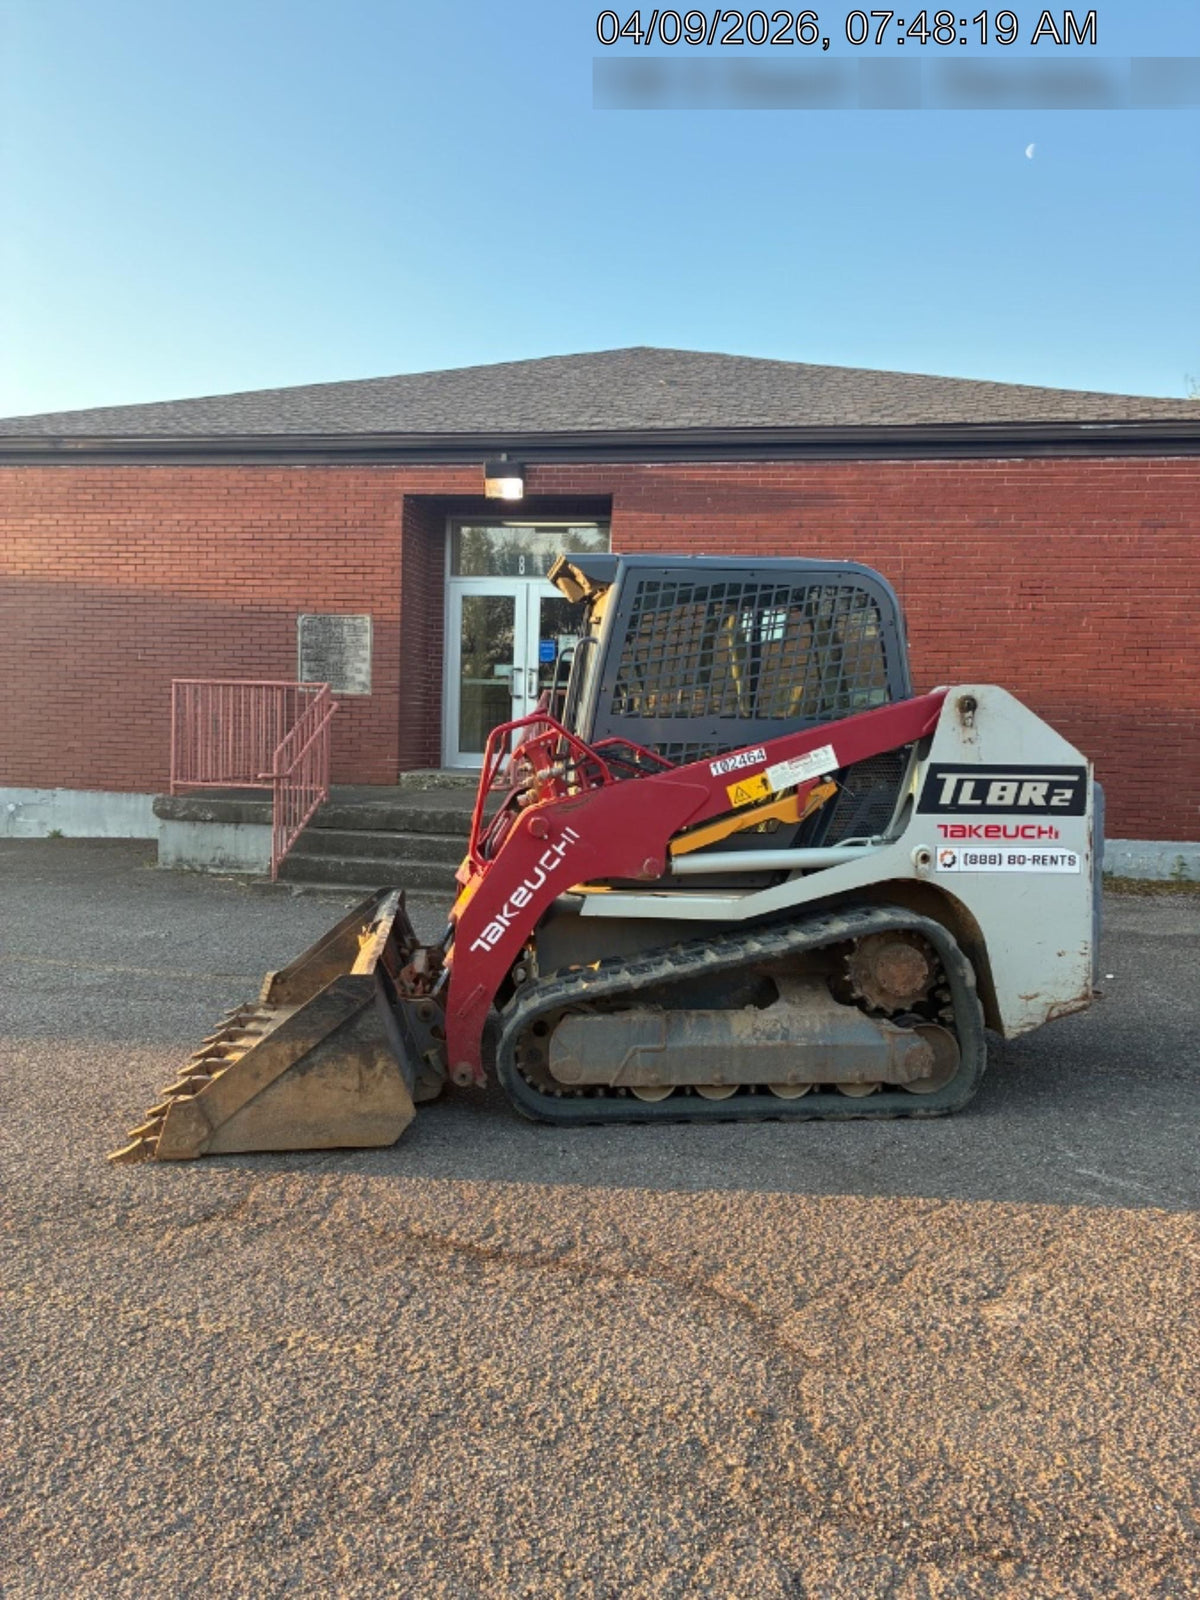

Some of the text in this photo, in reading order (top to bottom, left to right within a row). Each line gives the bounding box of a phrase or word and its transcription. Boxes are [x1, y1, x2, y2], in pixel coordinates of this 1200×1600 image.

[518, 555, 526, 575] 8
[711, 749, 766, 774] 102464
[936, 772, 1079, 806] TL8R2
[1007, 854, 1077, 867] 80-RENTS
